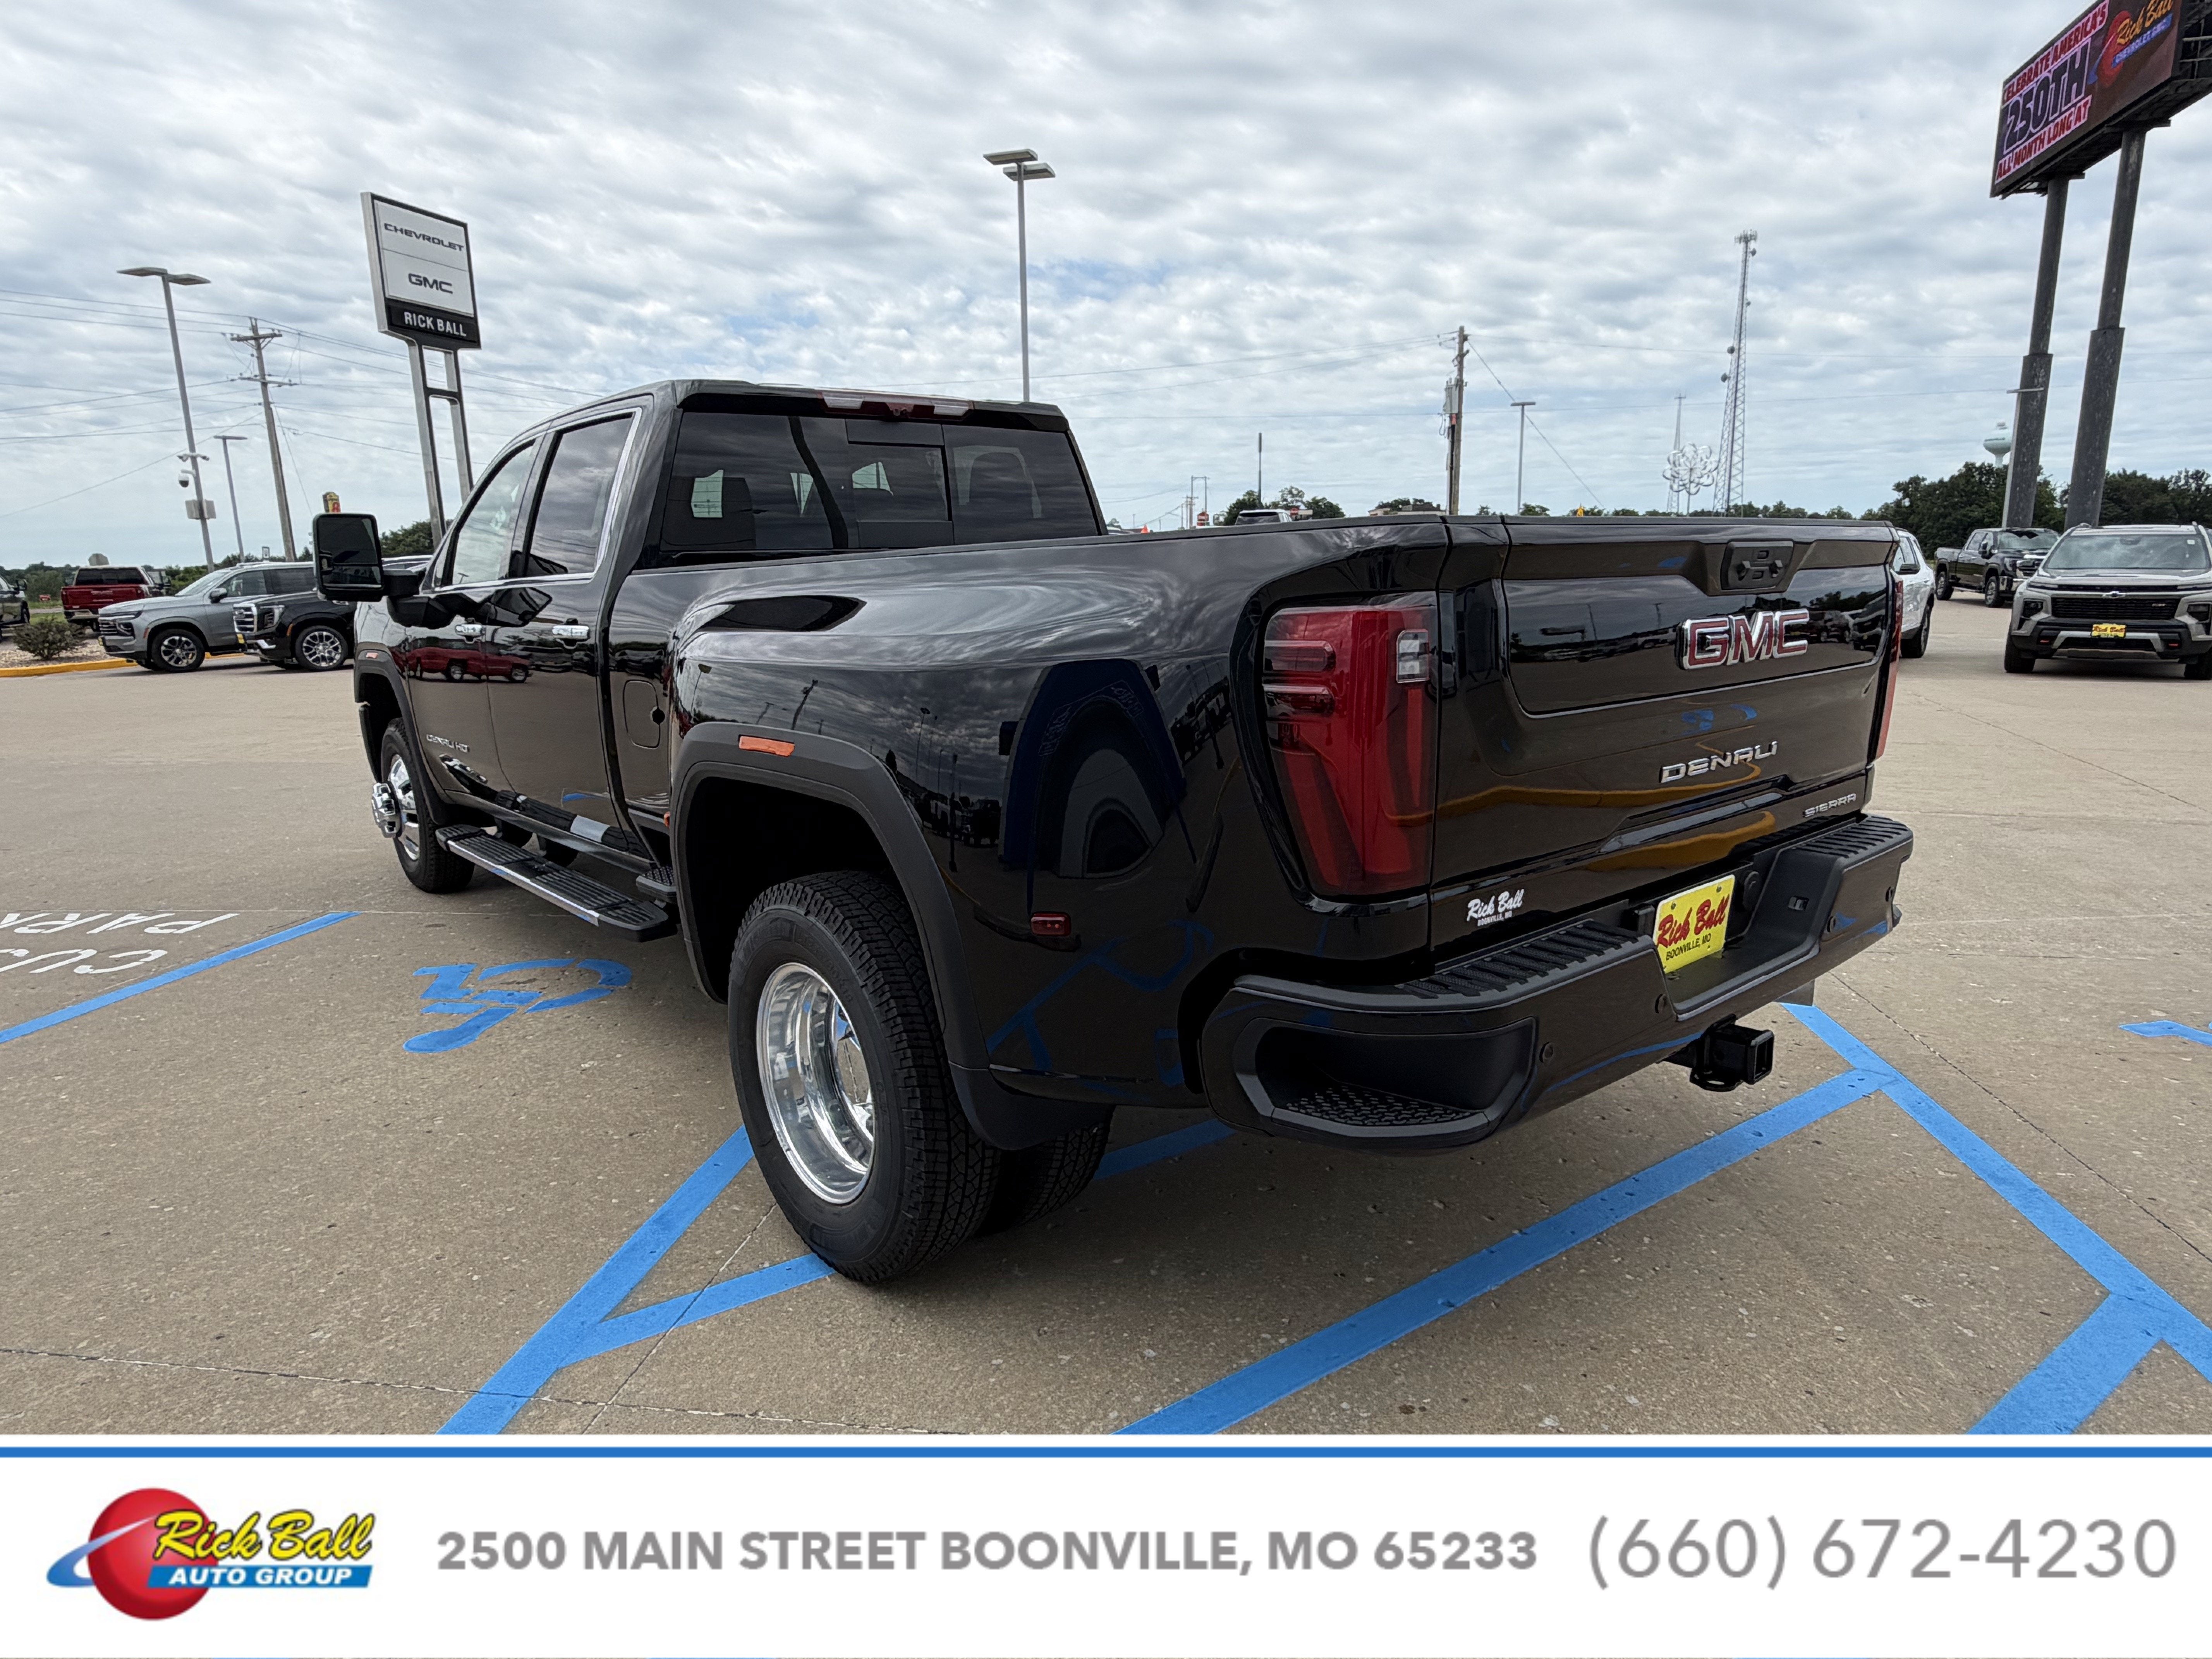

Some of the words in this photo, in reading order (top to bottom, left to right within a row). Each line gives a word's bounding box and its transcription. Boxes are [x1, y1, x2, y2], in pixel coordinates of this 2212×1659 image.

[2052, 2, 2107, 65] AMERICA'S
[2003, 36, 2091, 155] 250TH
[1996, 155, 2013, 180] ALL
[2013, 130, 2046, 169] MONTH
[2047, 110, 2073, 146] LONG
[2073, 98, 2090, 126] AT
[384, 223, 464, 252] CHEVROLET
[408, 273, 453, 294] GMC
[404, 311, 435, 330] RICK
[437, 319, 466, 337] BALL
[1679, 608, 1810, 670] GMC
[1659, 740, 1778, 783] DENALI
[1803, 793, 1856, 817] SIERRA
[1467, 895, 1496, 922] Rick
[1498, 888, 1524, 913] Ball
[1657, 907, 1693, 948] Rick
[1694, 893, 1730, 936] Ball
[0, 949, 167, 974] CU
[1666, 938, 1700, 960] BOONVILLE,
[1702, 933, 1712, 945] MO
